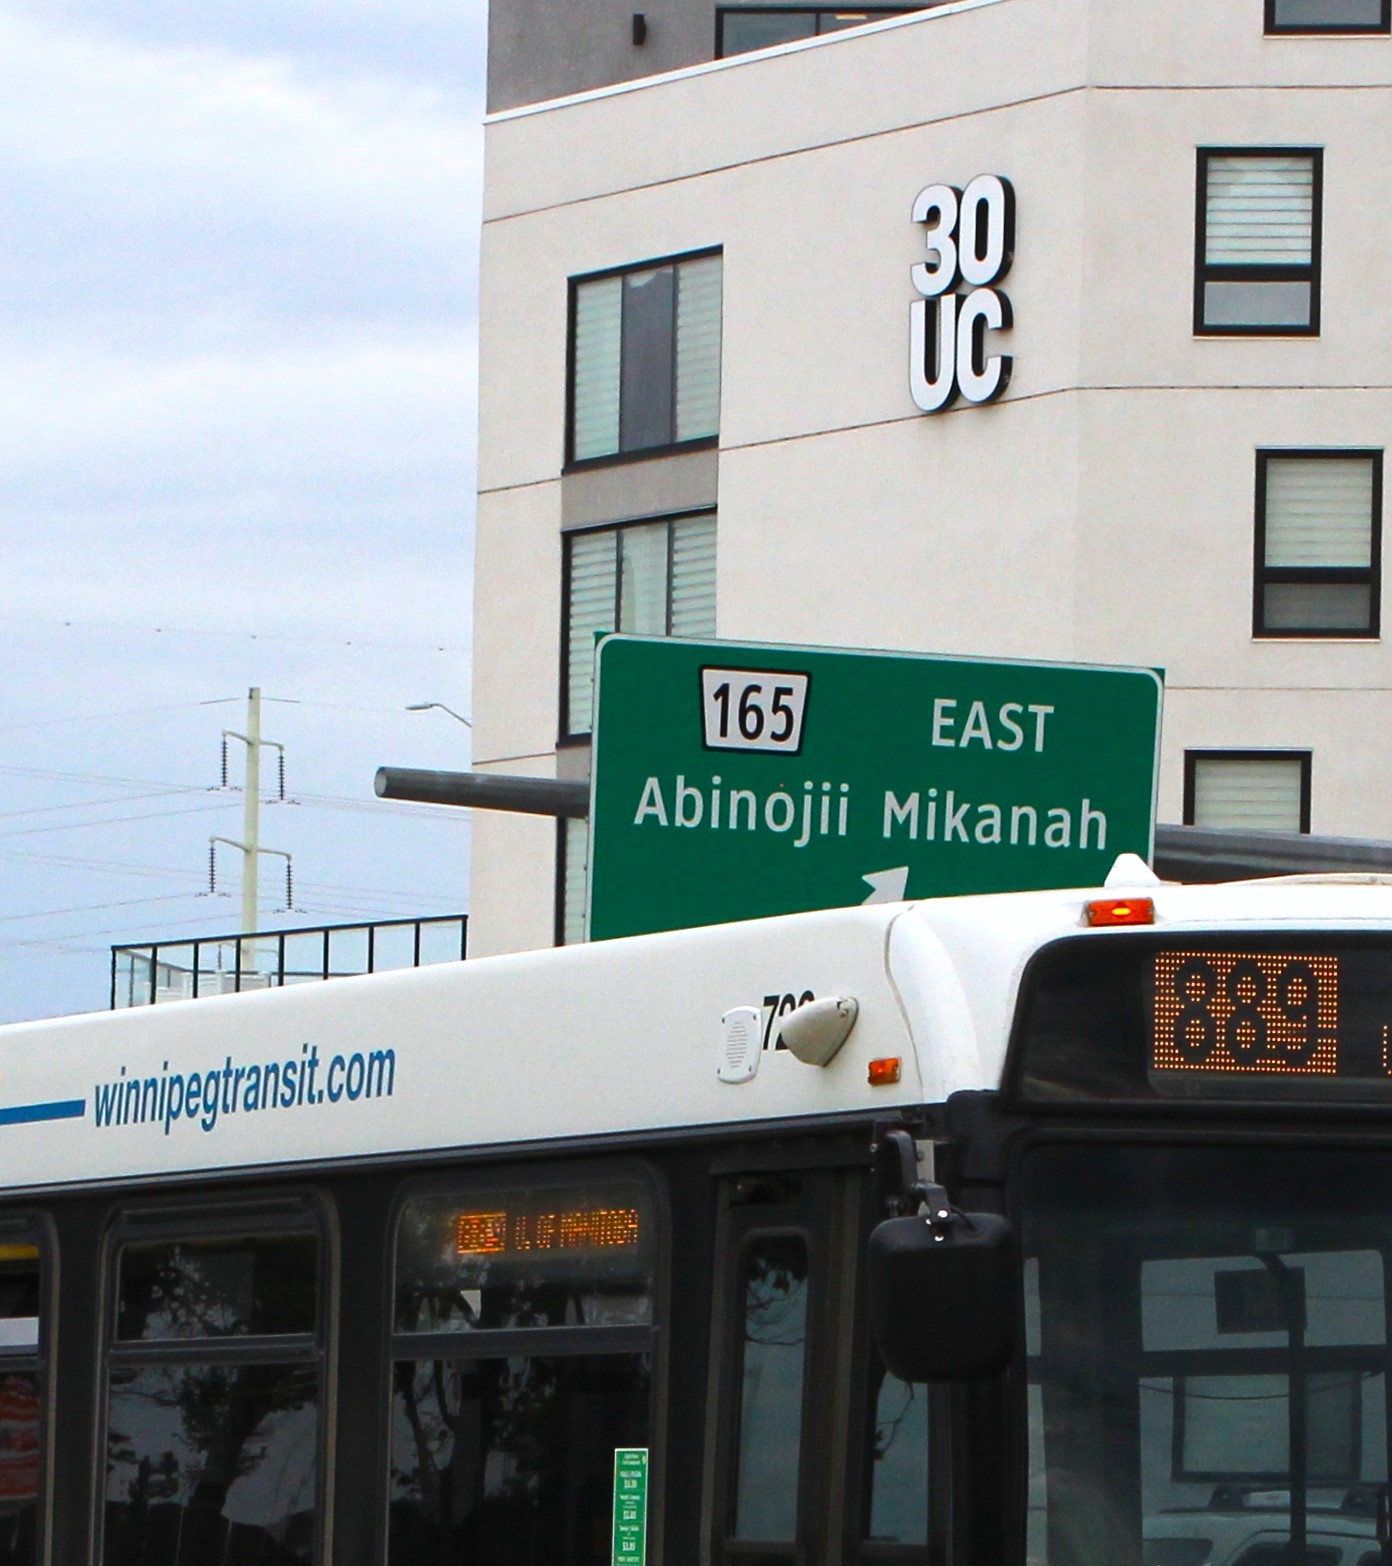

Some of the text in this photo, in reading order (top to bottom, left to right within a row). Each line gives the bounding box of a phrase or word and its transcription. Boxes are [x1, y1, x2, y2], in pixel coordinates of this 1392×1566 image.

[911, 174, 1014, 297] 30
[909, 287, 1012, 412] UC
[713, 682, 794, 743] 165
[931, 698, 1055, 752] EAST
[633, 774, 1108, 850] Abinojii Mikanah
[1168, 955, 1324, 1067] 889
[94, 1042, 396, 1136] winnipegtransit.com
